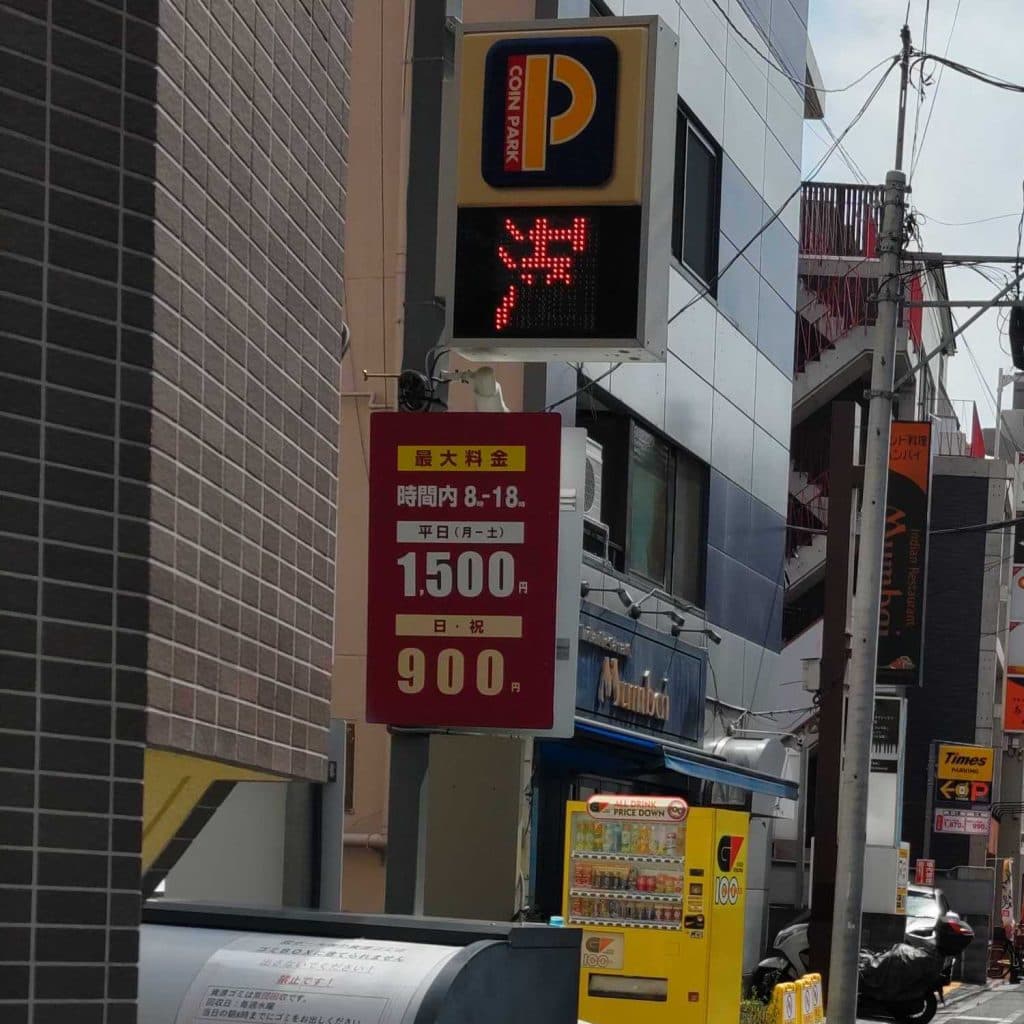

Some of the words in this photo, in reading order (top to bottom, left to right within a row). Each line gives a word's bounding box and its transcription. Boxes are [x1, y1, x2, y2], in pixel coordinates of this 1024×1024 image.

[507, 65, 523, 110] COIN
[505, 115, 522, 163] PARK
[414, 450, 509, 468] 最大料金
[397, 484, 458, 508] 時間内
[944, 751, 987, 767] Times
[613, 808, 636, 817] PRICE
[638, 808, 665, 817] DOWN
